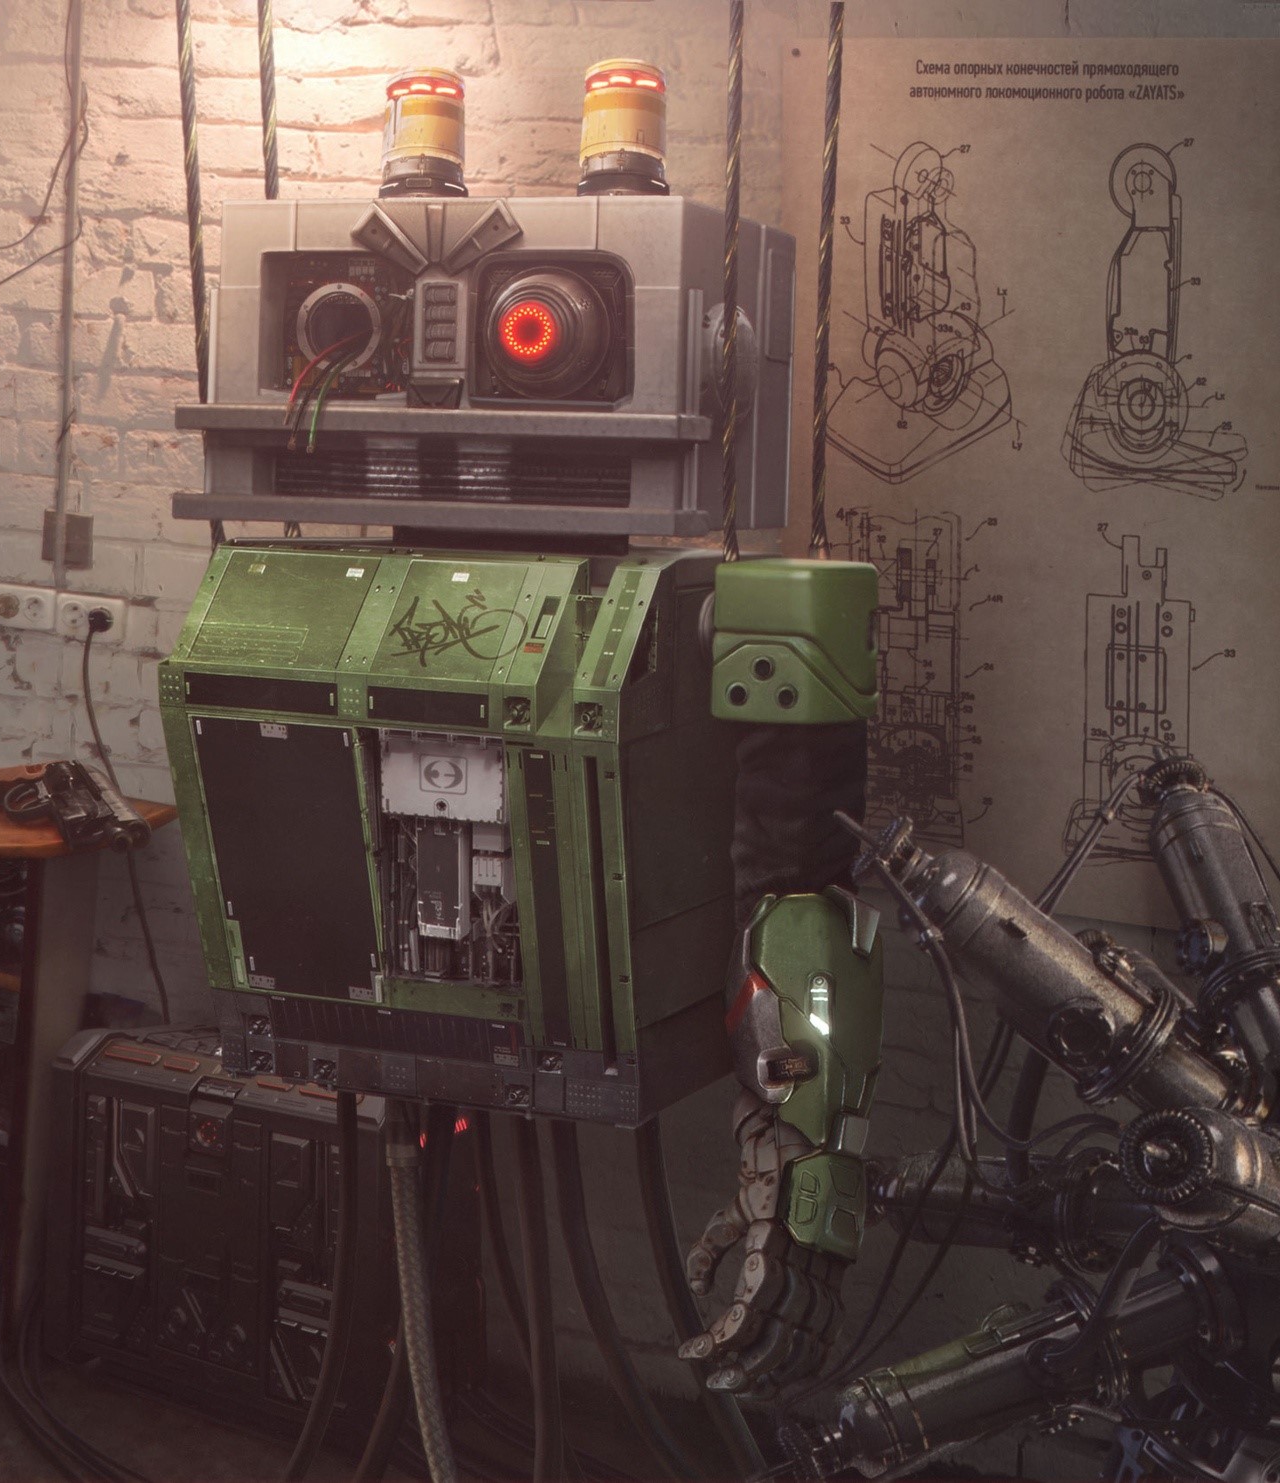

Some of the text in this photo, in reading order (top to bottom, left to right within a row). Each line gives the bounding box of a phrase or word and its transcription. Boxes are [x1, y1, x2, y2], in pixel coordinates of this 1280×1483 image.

[916, 59, 1179, 79] Схема опорных конечностей прямоходящего
[909, 84, 1185, 102] автономного локомоционного робота «ZAYATS»
[1184, 138, 1195, 147] 27
[960, 144, 971, 154] 27
[1097, 522, 1109, 532] 27
[1223, 647, 1236, 658] 33
